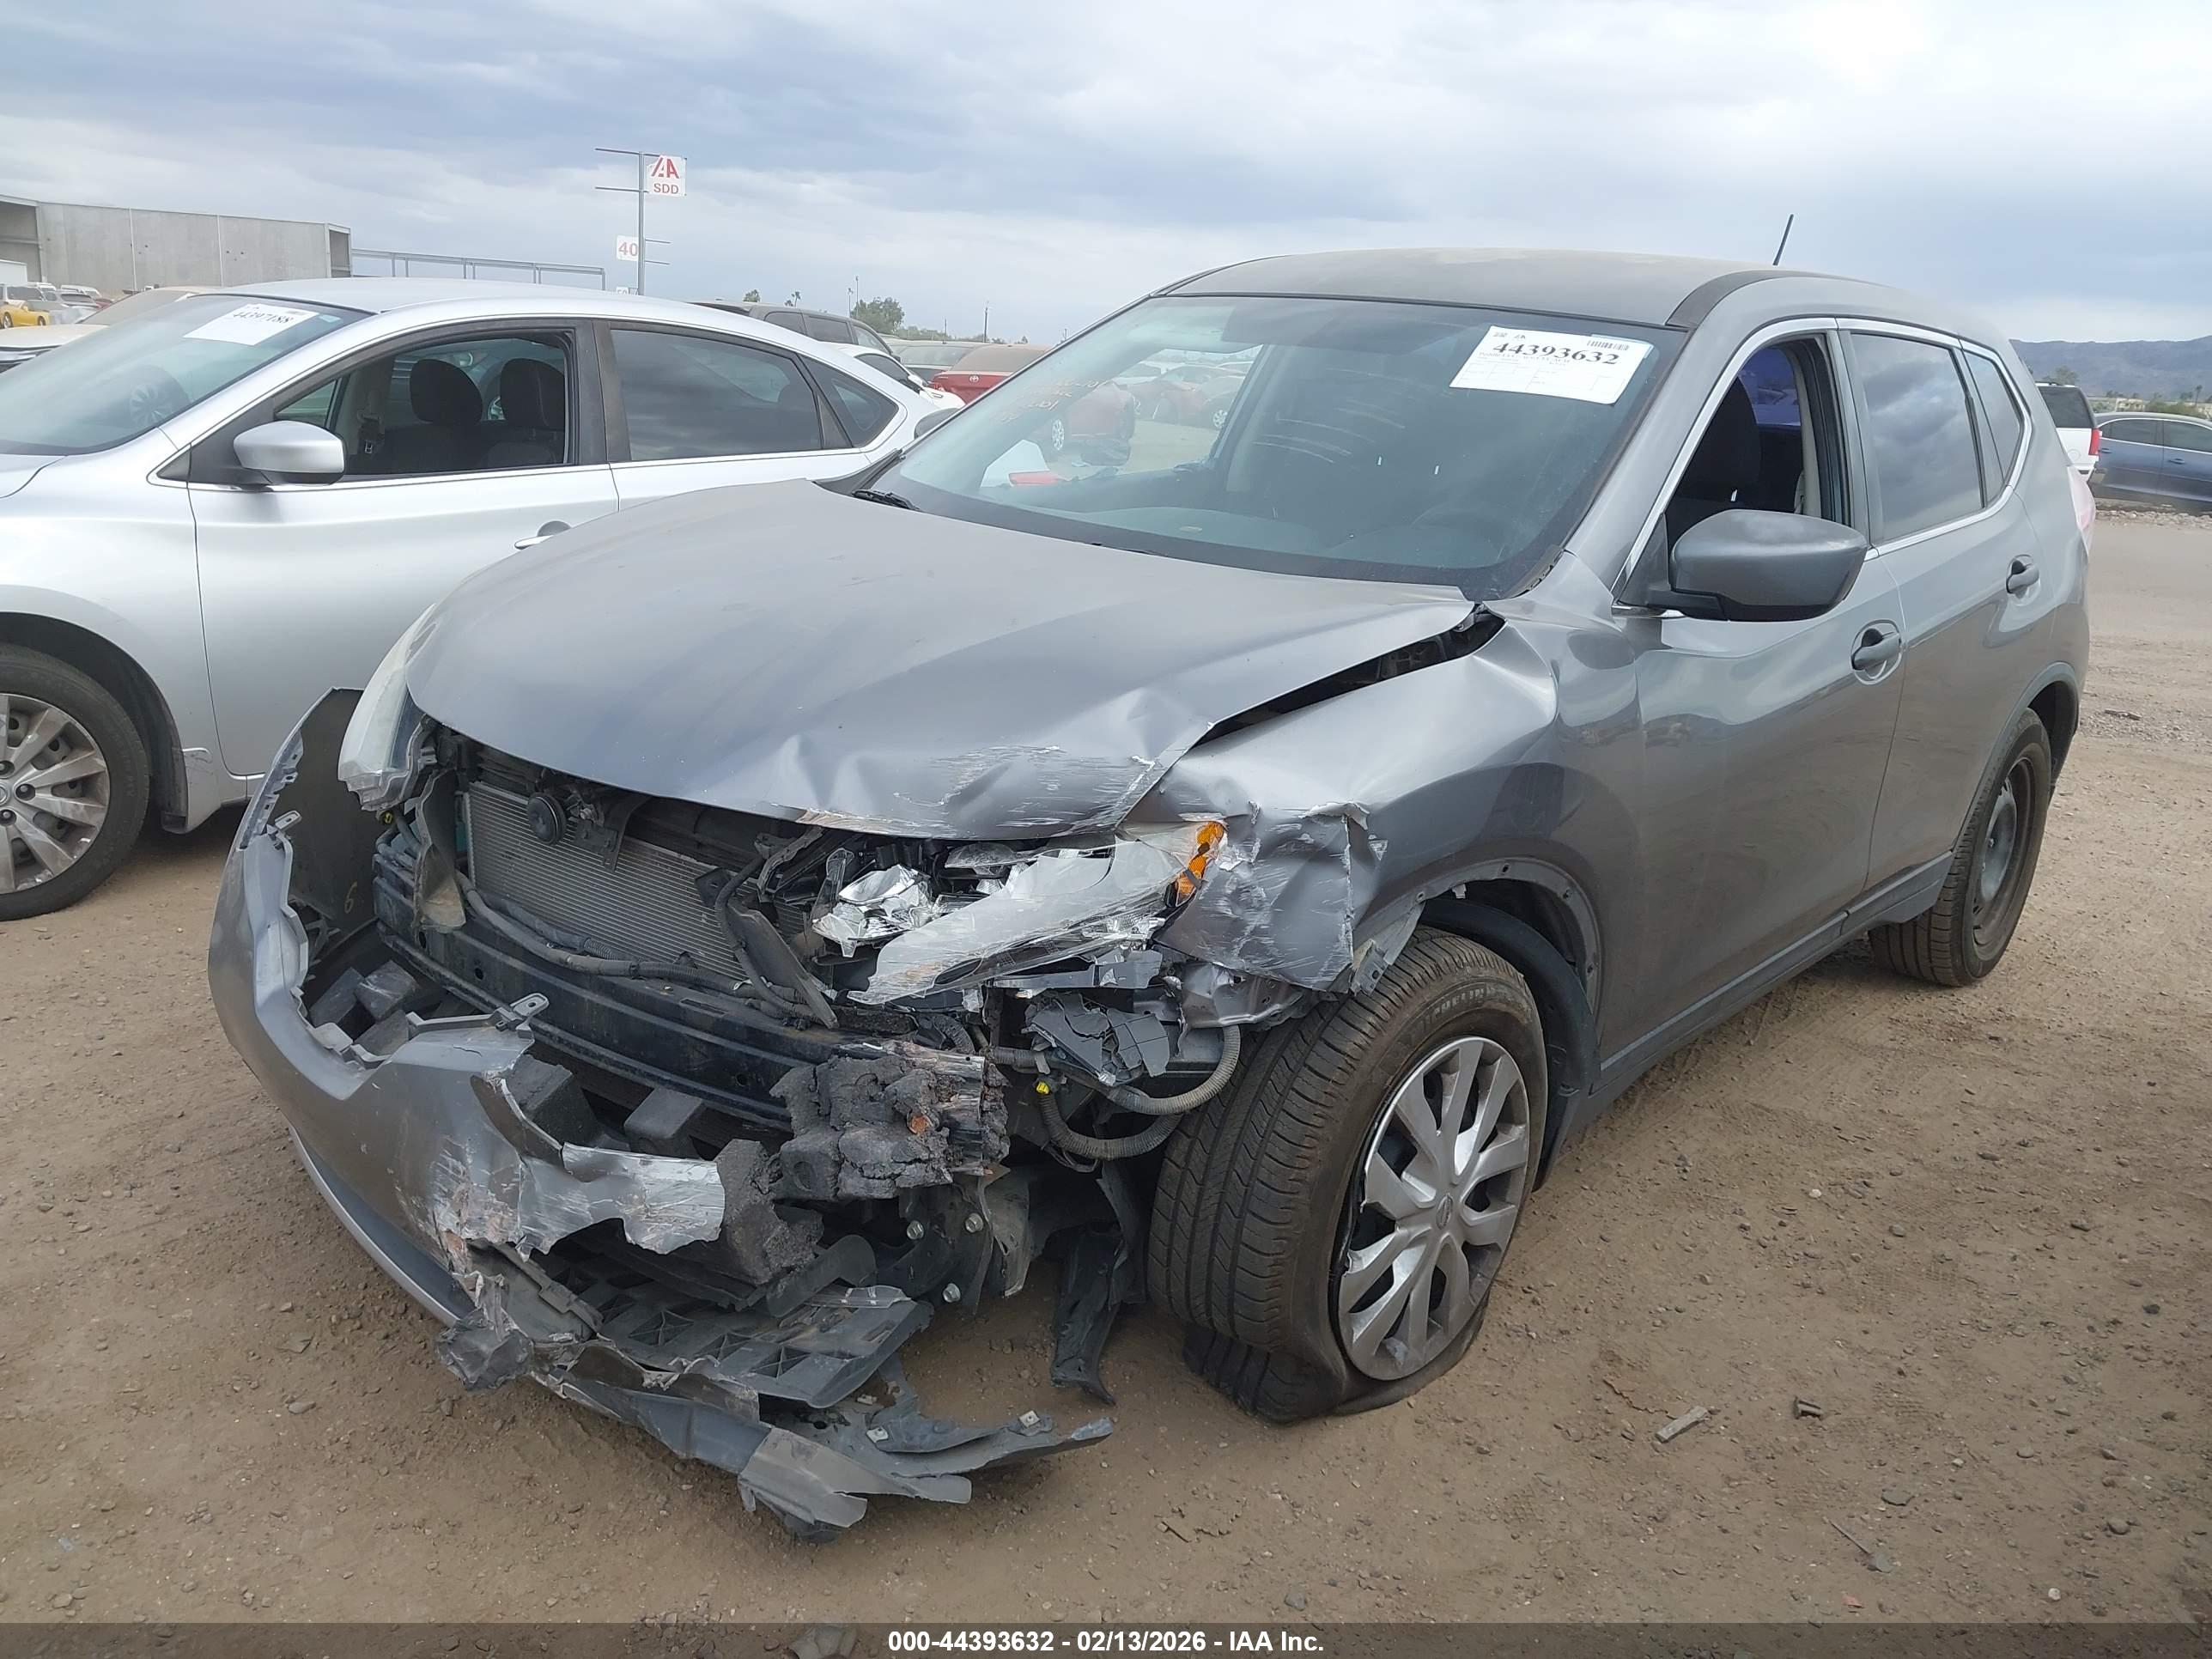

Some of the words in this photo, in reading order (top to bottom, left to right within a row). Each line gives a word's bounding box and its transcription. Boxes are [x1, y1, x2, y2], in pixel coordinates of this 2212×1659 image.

[653, 183, 679, 195] SDD
[618, 241, 638, 257] 40
[1492, 342, 1620, 365] 44393632
